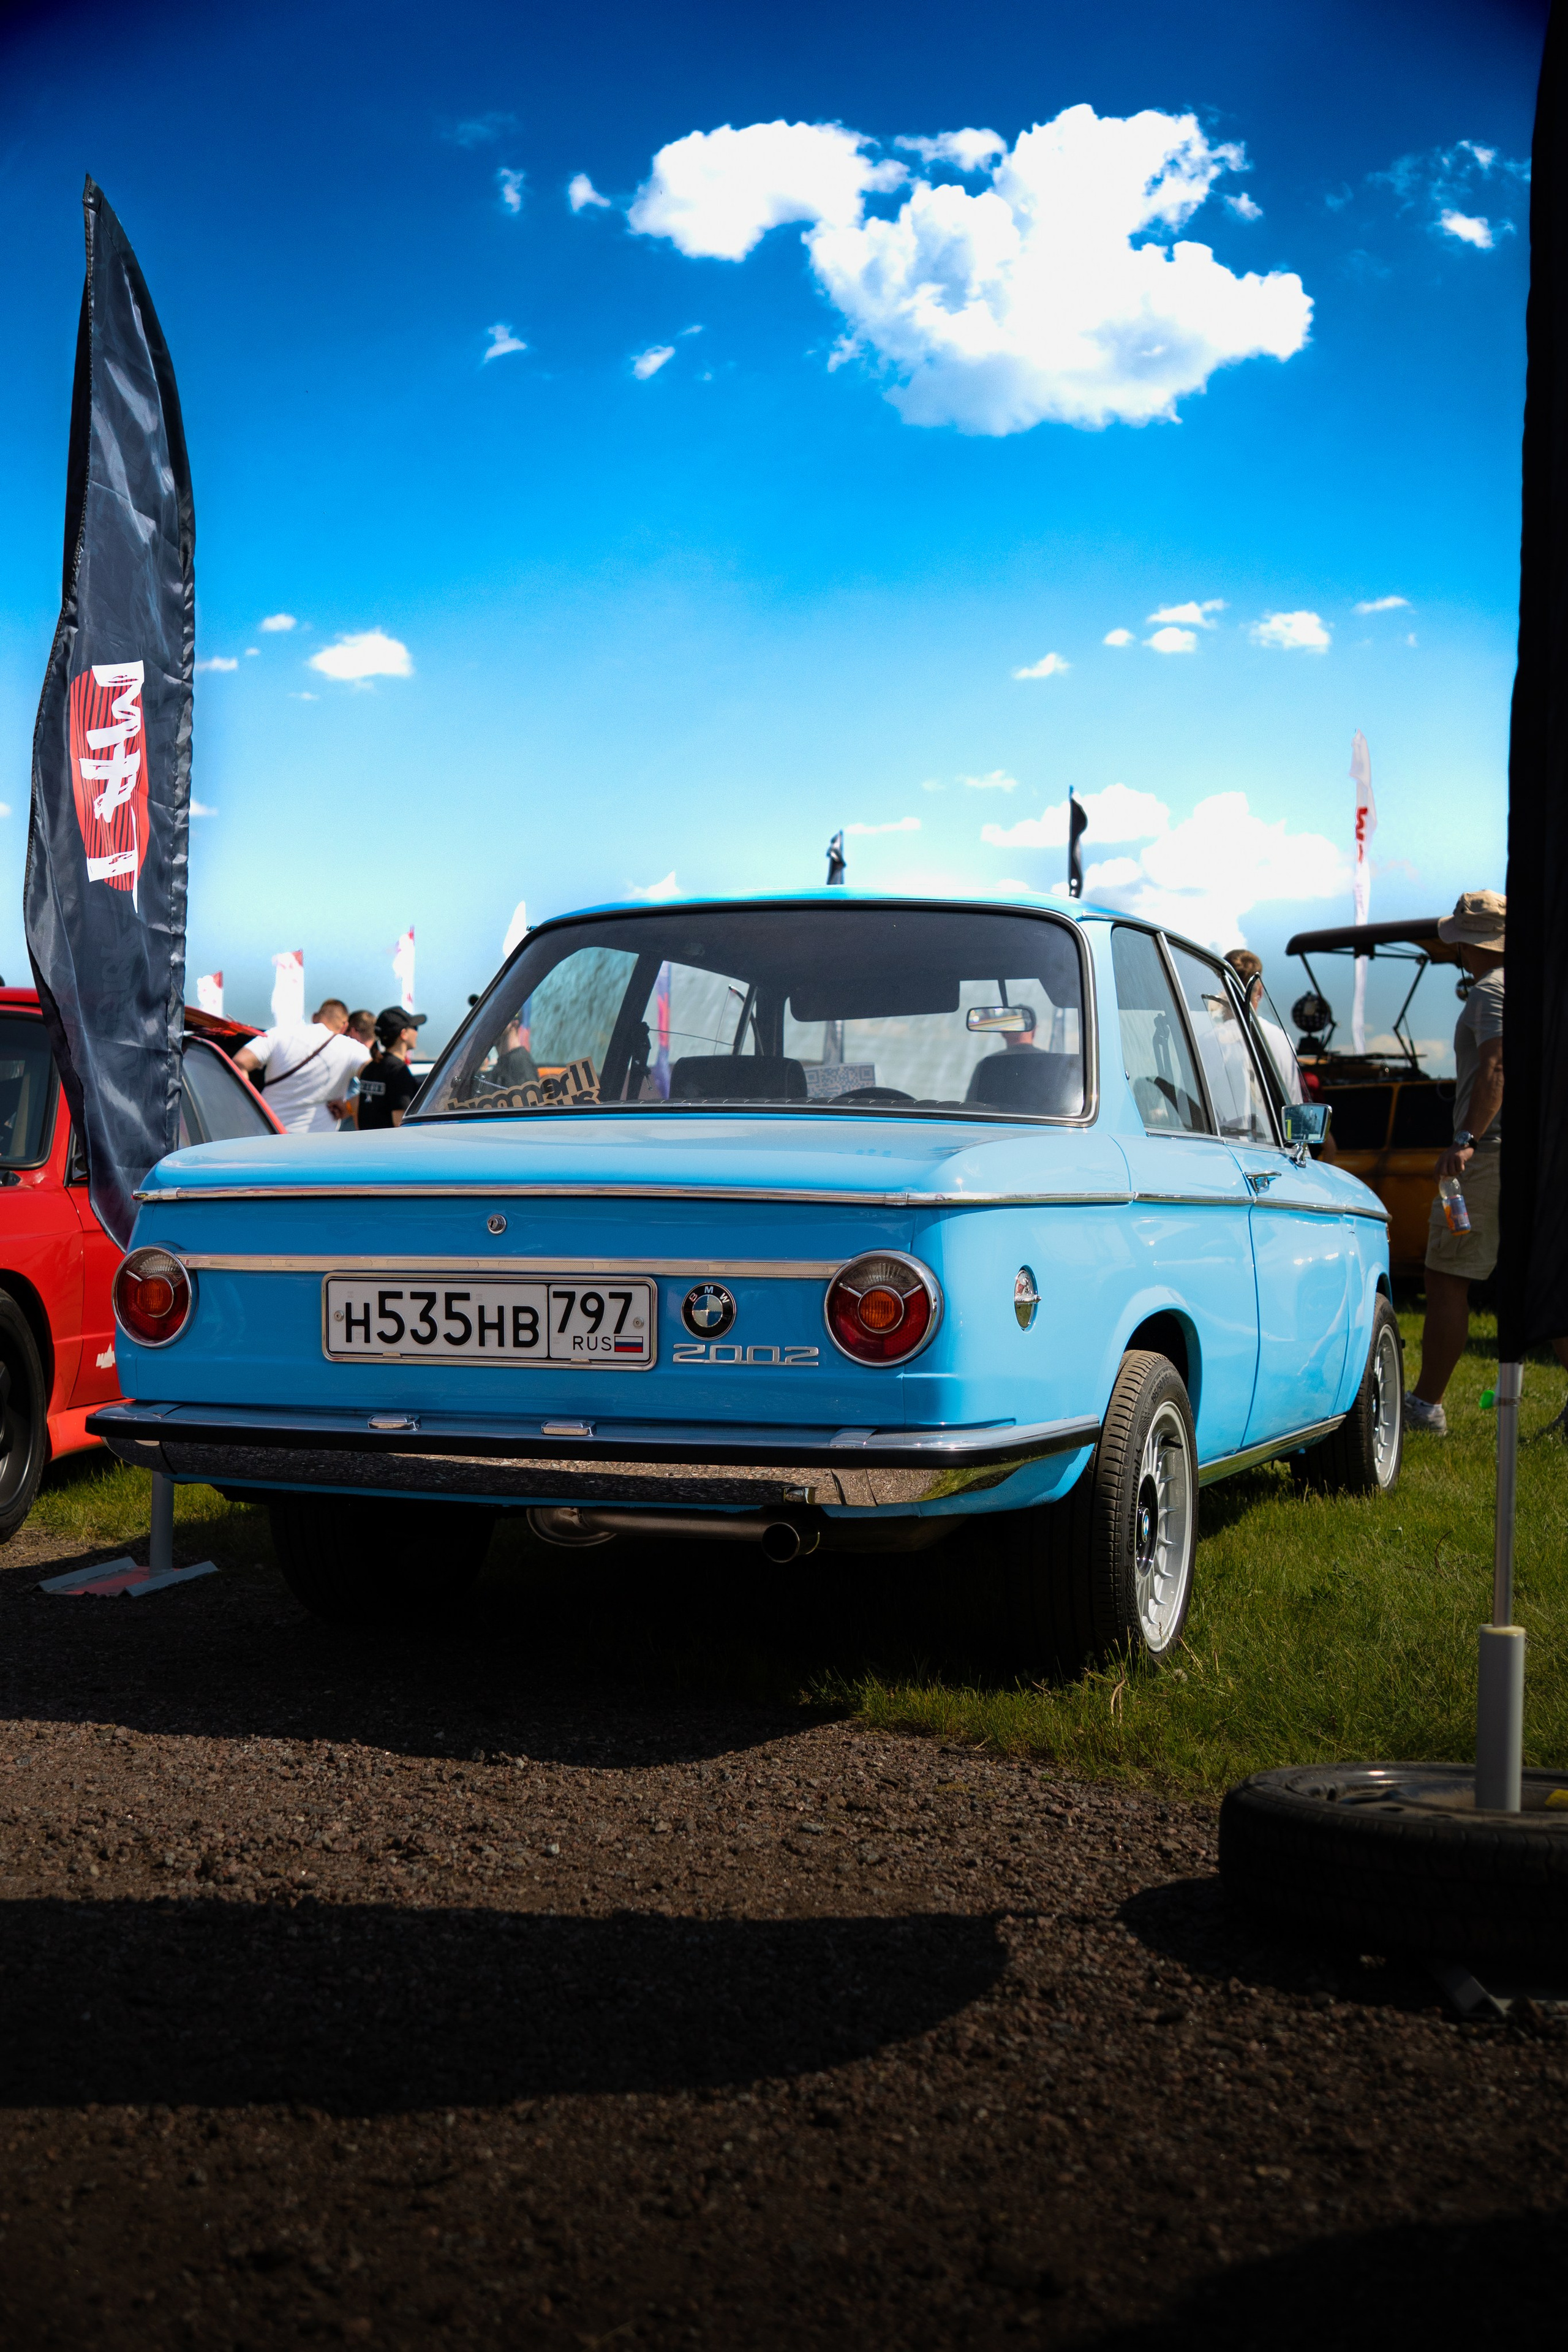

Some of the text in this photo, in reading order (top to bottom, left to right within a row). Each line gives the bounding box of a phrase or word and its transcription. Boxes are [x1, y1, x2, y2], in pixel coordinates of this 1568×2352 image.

[552, 1291, 633, 1335] 797
[573, 1335, 611, 1351] RUS
[673, 1343, 819, 1366] 2002
[1127, 1460, 1142, 1556] Continental
